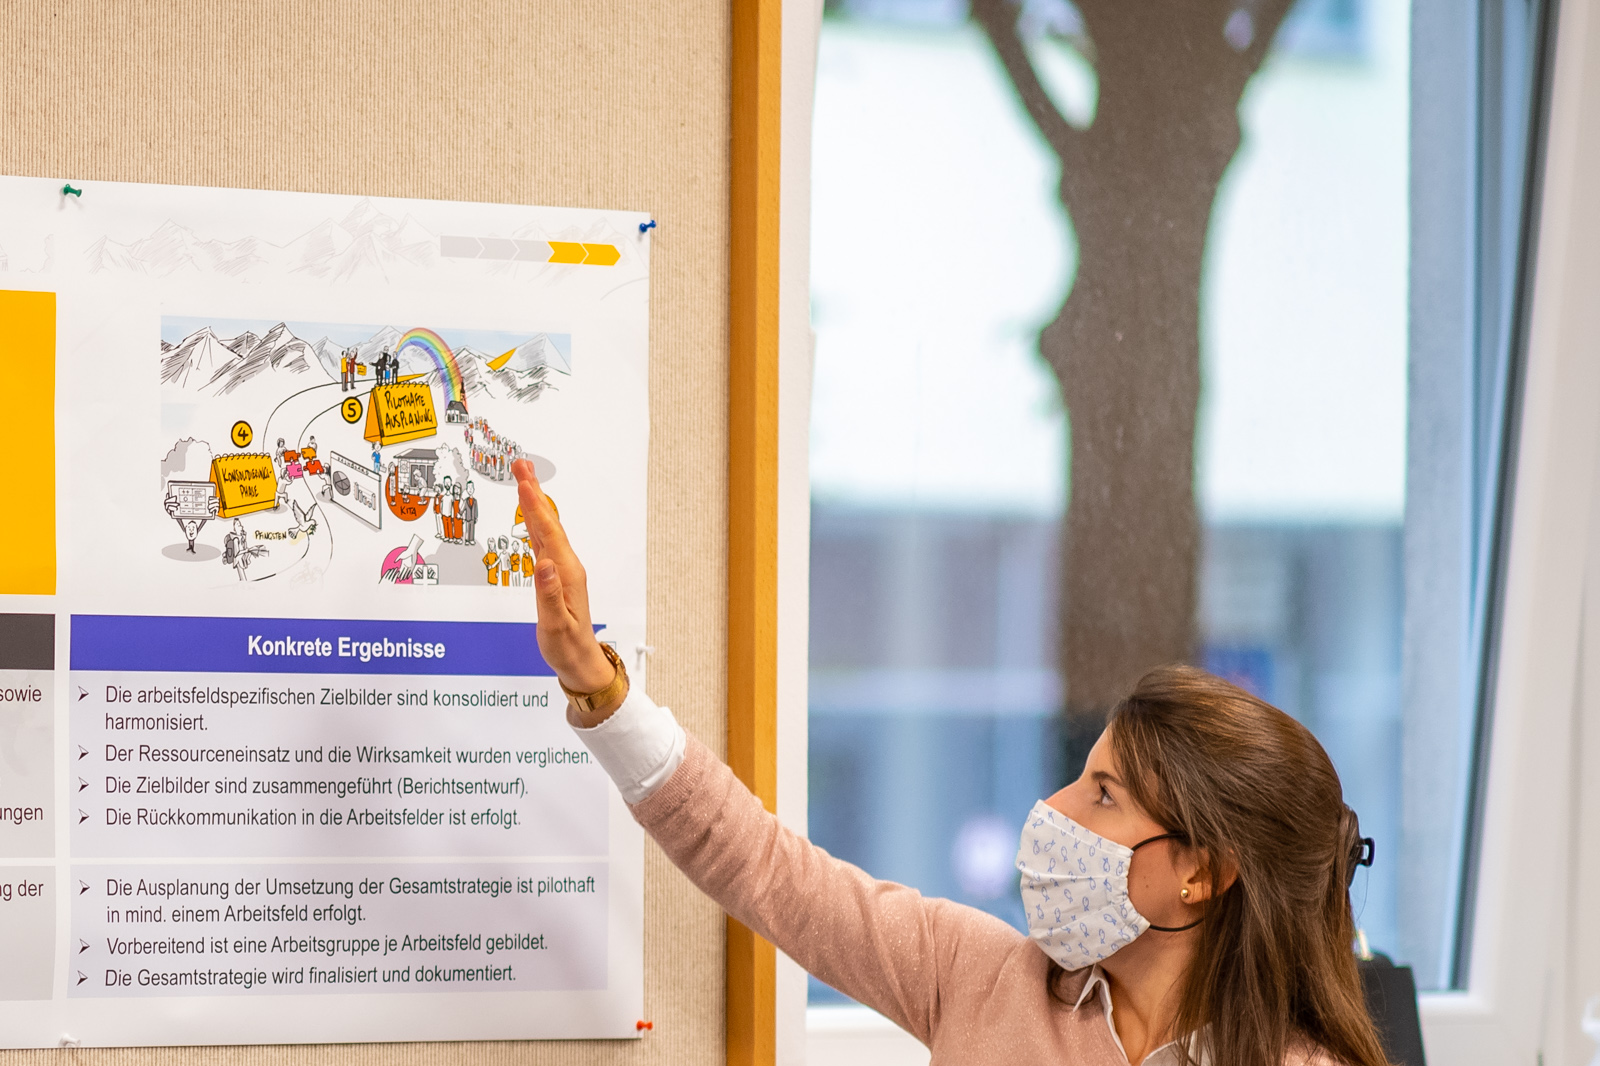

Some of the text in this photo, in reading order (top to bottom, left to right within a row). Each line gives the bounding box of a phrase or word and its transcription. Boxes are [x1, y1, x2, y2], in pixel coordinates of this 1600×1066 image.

[347, 402, 357, 418] 5
[237, 427, 249, 441] 4
[247, 634, 446, 663] Konkrete Ergebnisse
[105, 684, 549, 710] Die arbeitsfeldspezifischen Zielbilder sind konsolidiert und
[105, 711, 208, 731] harmonisiert.
[105, 743, 594, 768] Der Ressourceneinsatz und die Wirksamkeit wurden verglichen.
[105, 775, 529, 800] Die Zielbilder sind zusammengeführt (Berichtsentwurf).
[106, 807, 521, 831] Die Rückkommunikation in die Arbeitsfelder ist erfolgt.
[17, 878, 45, 898] der
[106, 875, 595, 901] Die Ausplanung der Umsetzung der Gesamtstrategie ist pilothaft
[106, 903, 366, 927] in mind. einem Arbeitsfeld erfolgt.
[106, 932, 548, 958] Vorbereitend ist eine Arbeitsgruppe je Arbeitsfeld gebildet.
[104, 963, 516, 991] Die Gesamtstrategie wird finalisiert und dokumentiert.
